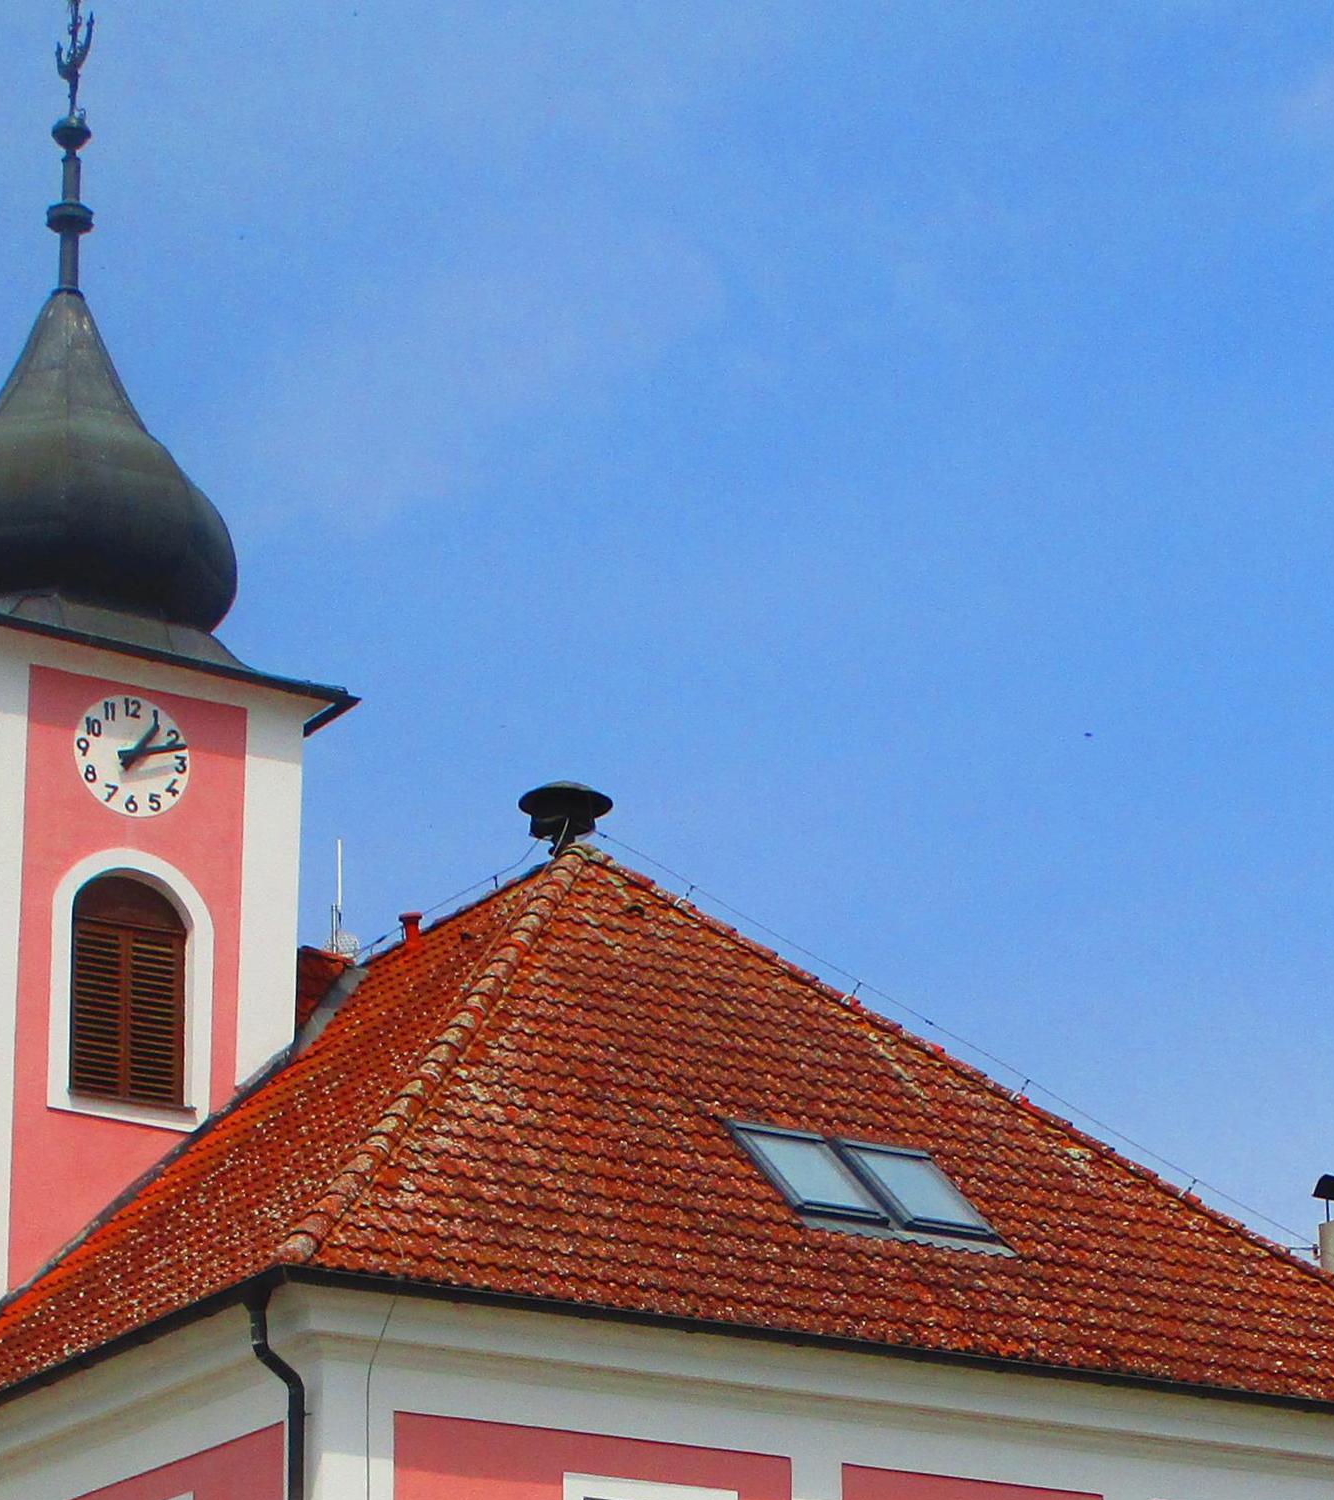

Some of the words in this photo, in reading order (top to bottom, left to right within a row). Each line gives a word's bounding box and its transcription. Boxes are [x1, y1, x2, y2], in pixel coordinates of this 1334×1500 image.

[103, 701, 115, 721] 11
[124, 697, 141, 719] 12
[85, 716, 102, 738] 10
[76, 737, 90, 757] 9
[84, 764, 97, 783] 8
[174, 754, 187, 774] 3
[104, 783, 119, 803] 7
[165, 778, 180, 797] 4
[125, 794, 138, 813] 6
[148, 793, 162, 812] 5
